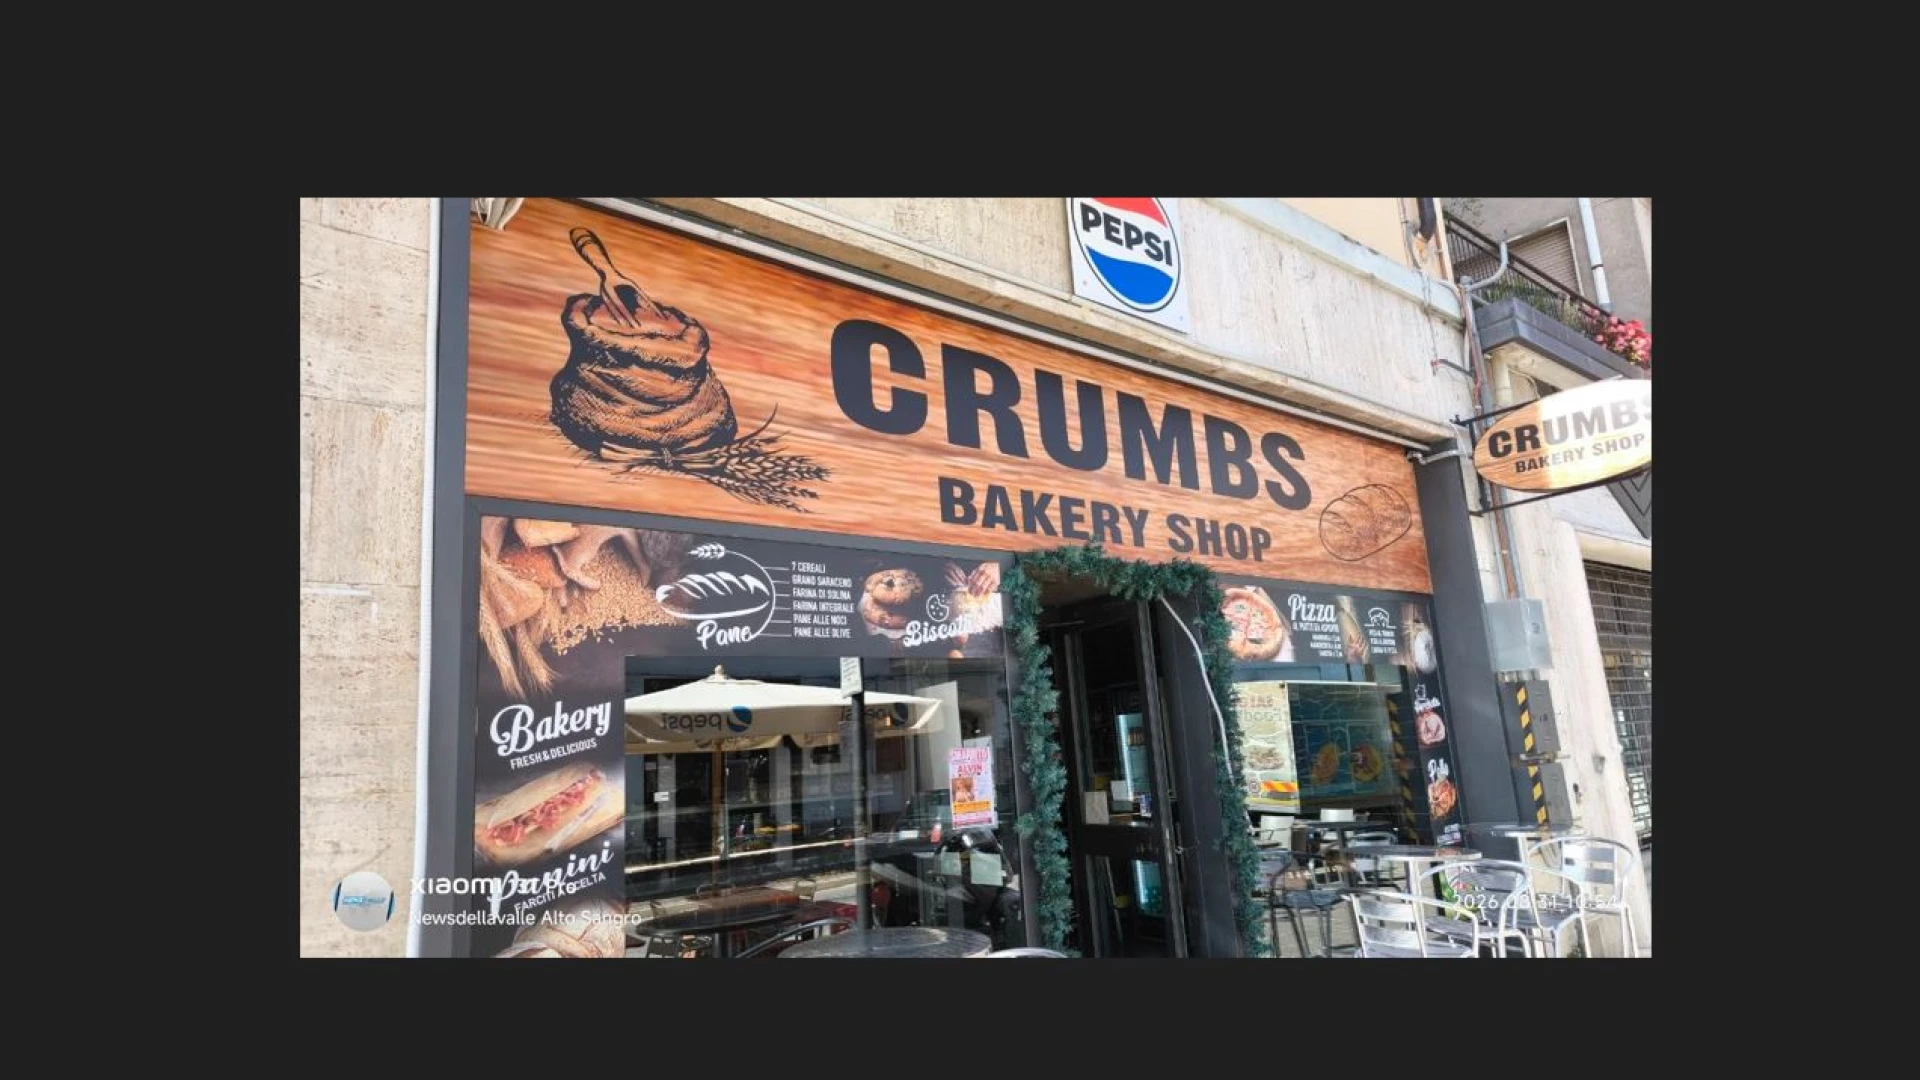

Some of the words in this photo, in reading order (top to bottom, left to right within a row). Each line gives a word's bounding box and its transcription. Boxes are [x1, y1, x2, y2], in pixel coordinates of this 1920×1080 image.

[1080, 203, 1173, 267] PEPSI
[830, 318, 1313, 511] CRUMBS
[1515, 446, 1586, 473] BAKERY
[1592, 432, 1646, 457] SHOP
[938, 477, 1149, 548] BAKERY
[1167, 513, 1272, 562] SHOP
[792, 561, 797, 571] 7
[798, 561, 826, 574] CEREALI
[792, 574, 815, 586] GRANO
[817, 576, 852, 588] SARACENO
[793, 587, 817, 599] FARINA
[818, 588, 826, 599] DI
[793, 601, 816, 612] FARINA
[817, 602, 855, 614] INTEGRALE
[1287, 593, 1337, 623] Pizza
[696, 619, 755, 650] Pane
[794, 613, 811, 625] PANE
[812, 614, 832, 625] ALLE
[833, 615, 847, 626] NOCI
[794, 627, 811, 639] PANE
[812, 627, 832, 639] ALLE
[833, 628, 851, 639] OLIVE
[490, 700, 612, 757] Bakery
[510, 753, 542, 770] FRESH
[551, 737, 597, 759] DELICIOUS
